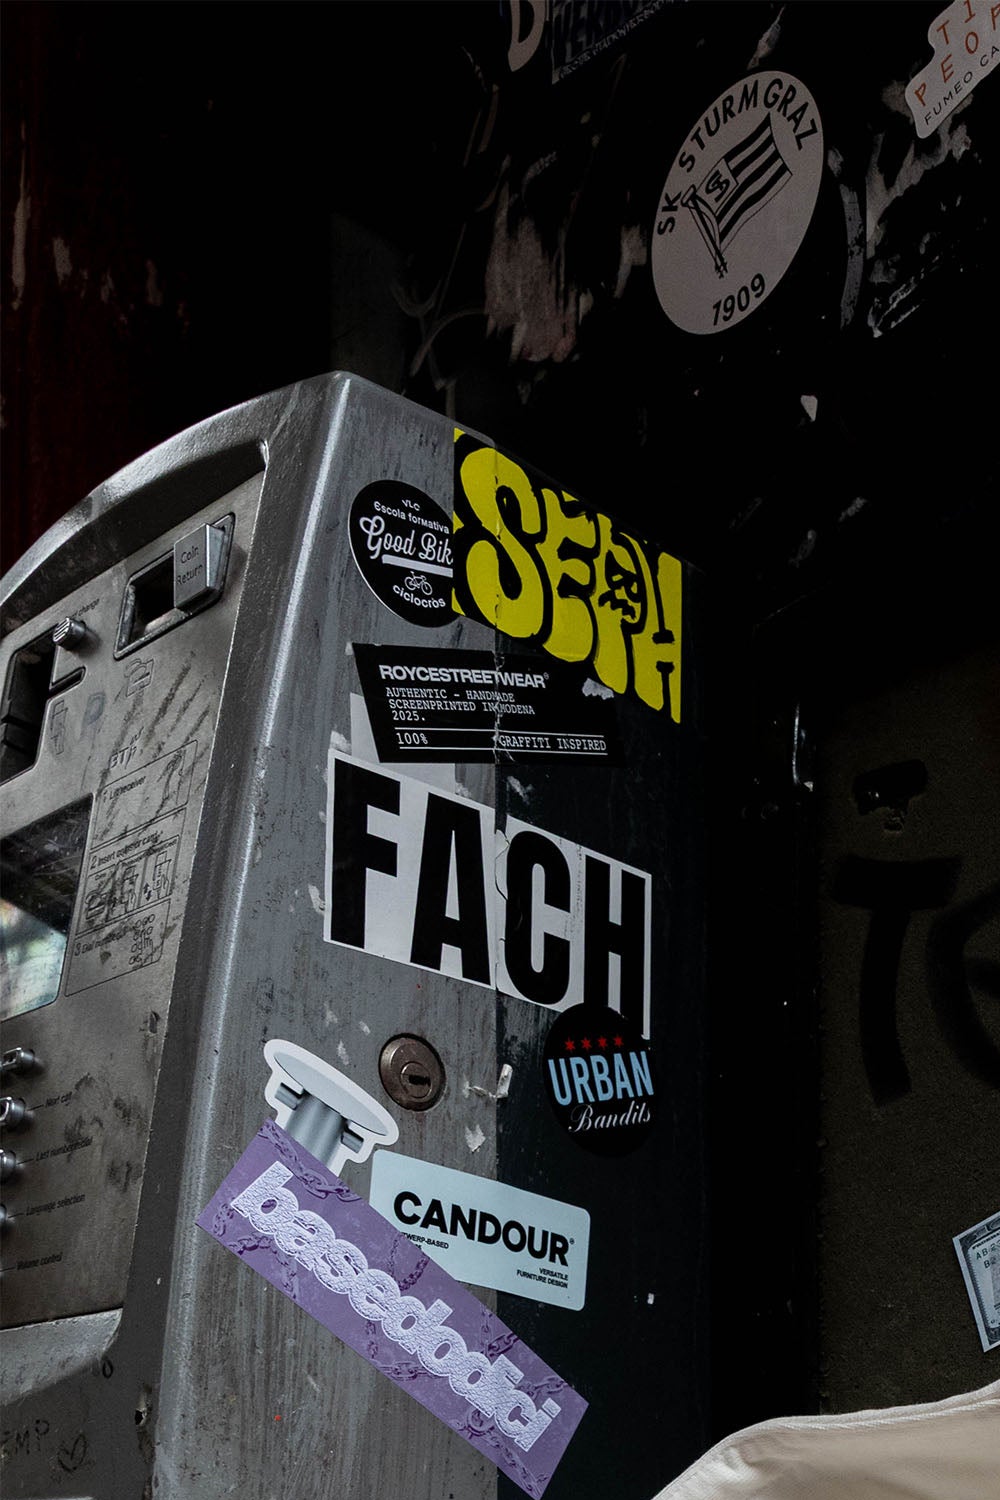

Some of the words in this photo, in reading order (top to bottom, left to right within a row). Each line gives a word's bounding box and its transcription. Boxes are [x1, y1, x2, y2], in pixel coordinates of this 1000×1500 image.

[924, 71, 974, 126] FUMEO
[656, 190, 682, 236] SK
[711, 272, 766, 326] 1909
[358, 514, 418, 560] Good
[385, 686, 448, 701] AUTHENTIC
[466, 690, 516, 704] HANDMADE
[388, 698, 477, 712] SCREENPRINTED
[498, 703, 536, 717] MODENA
[392, 710, 427, 723] 2025.
[395, 732, 429, 746] 100%
[498, 734, 551, 750] GRAFFITI
[556, 738, 607, 752] INSPIRED
[330, 757, 646, 1040] FACH
[547, 1050, 655, 1106] URBAN
[567, 1102, 653, 1133] Bandits
[403, 1231, 450, 1250] TWERP-BASED
[516, 1269, 547, 1285] FURNITURE
[547, 1277, 569, 1290] DESIGN
[539, 1267, 569, 1281] VERSATILE
